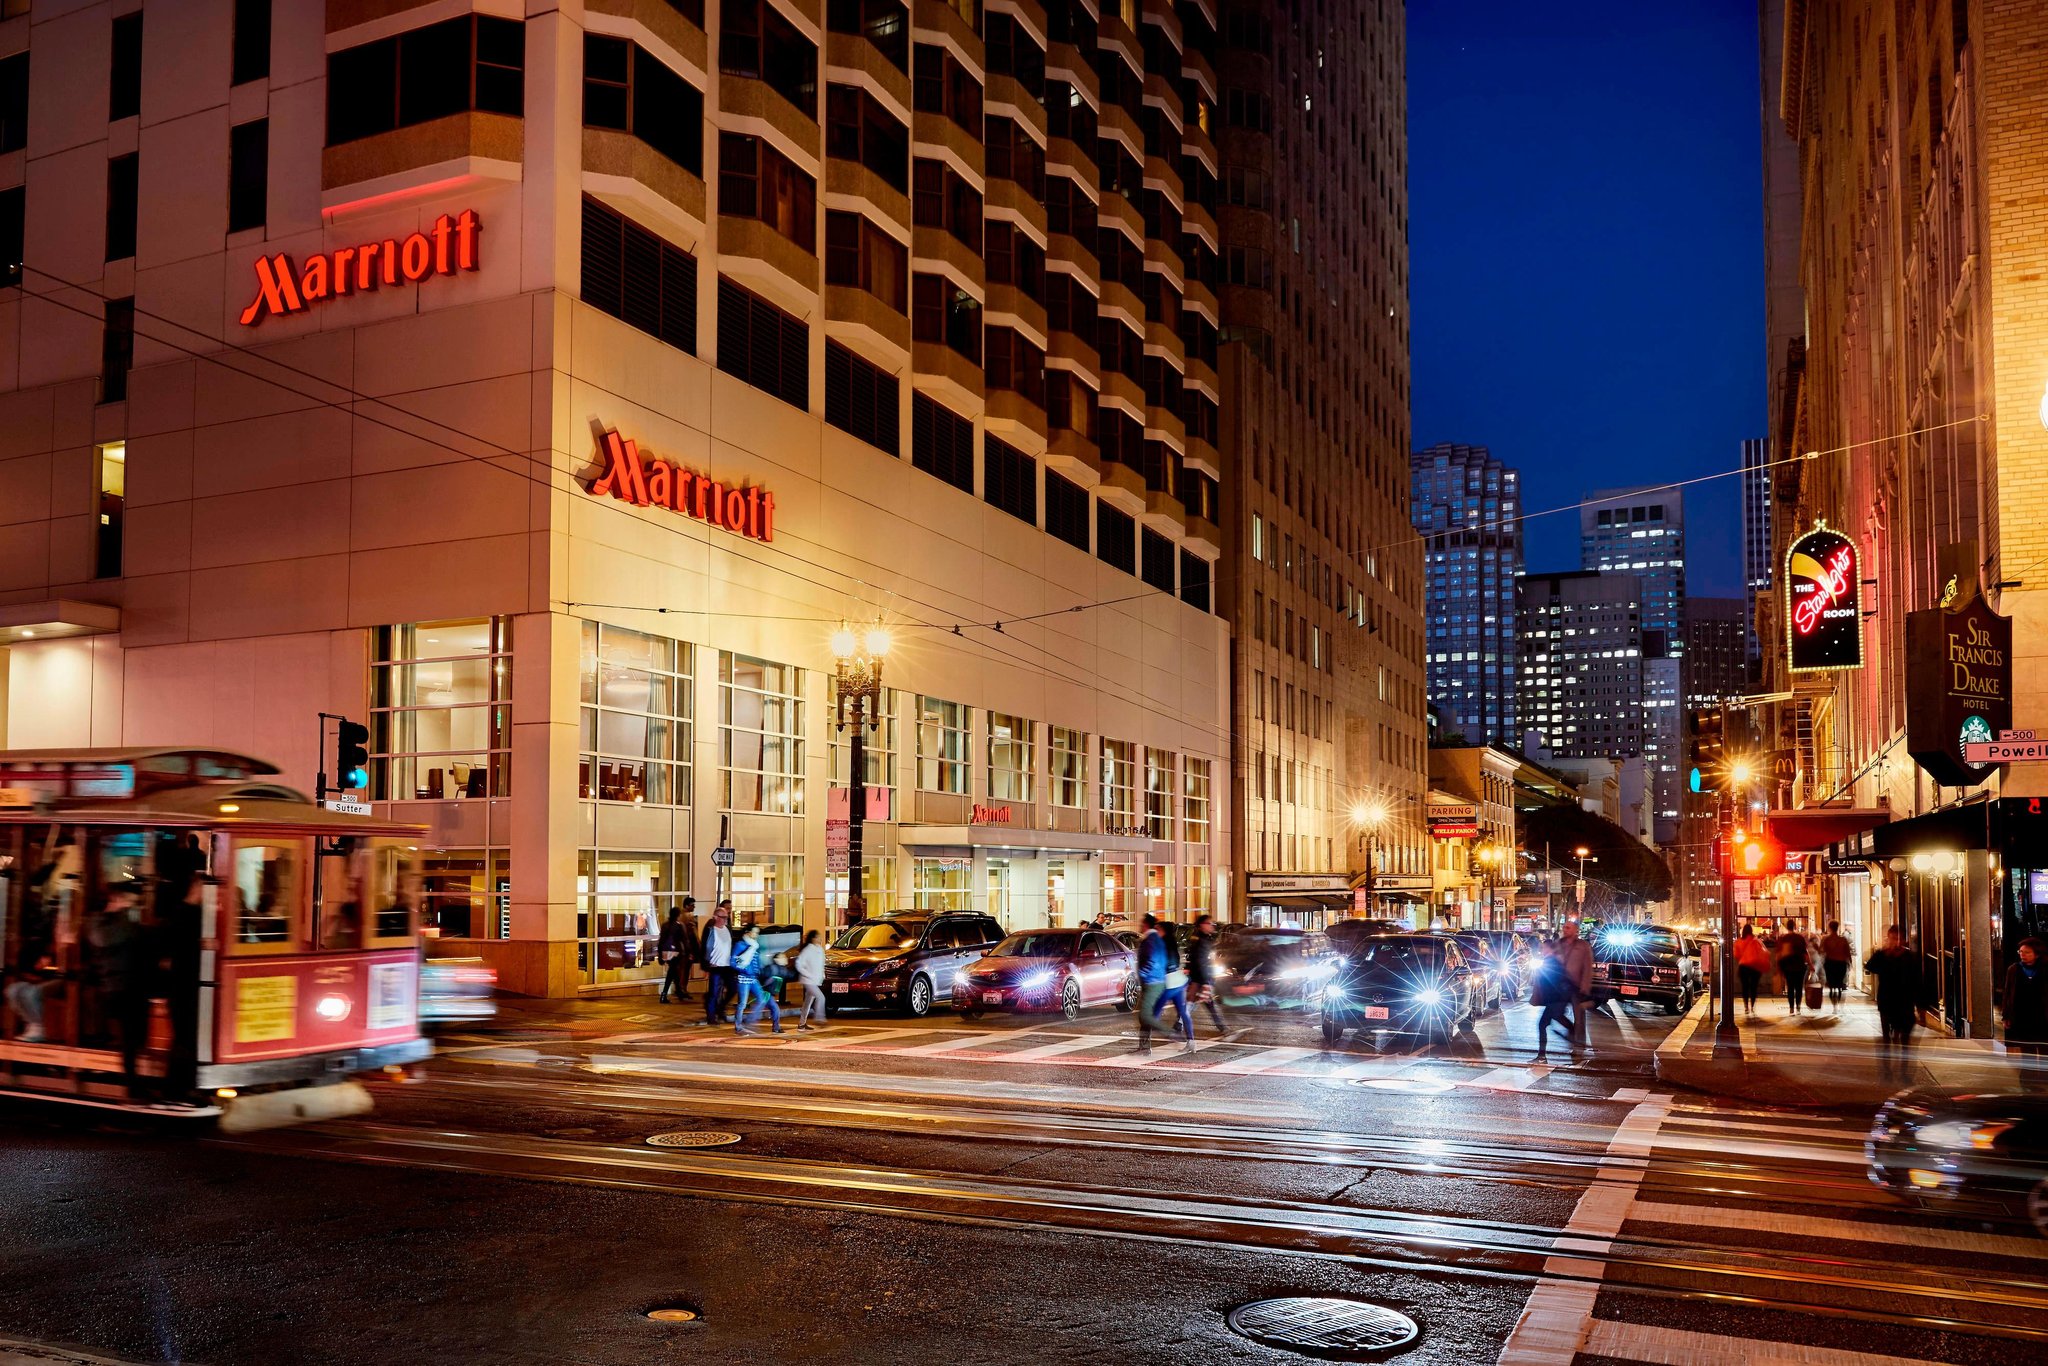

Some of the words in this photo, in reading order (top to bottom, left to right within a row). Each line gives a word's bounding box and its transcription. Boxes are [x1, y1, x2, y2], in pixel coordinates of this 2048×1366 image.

[240, 209, 482, 326] Marriott
[591, 430, 775, 542] Marriott
[1794, 584, 1815, 592] THE
[1795, 547, 1850, 633] Starlight
[1823, 609, 1855, 618] ROOM
[1963, 699, 1989, 710] HOTEL
[2012, 731, 2033, 740] 500
[335, 803, 362, 813] Sutter
[1431, 807, 1472, 815] PARKING
[971, 804, 1011, 825] Marriott
